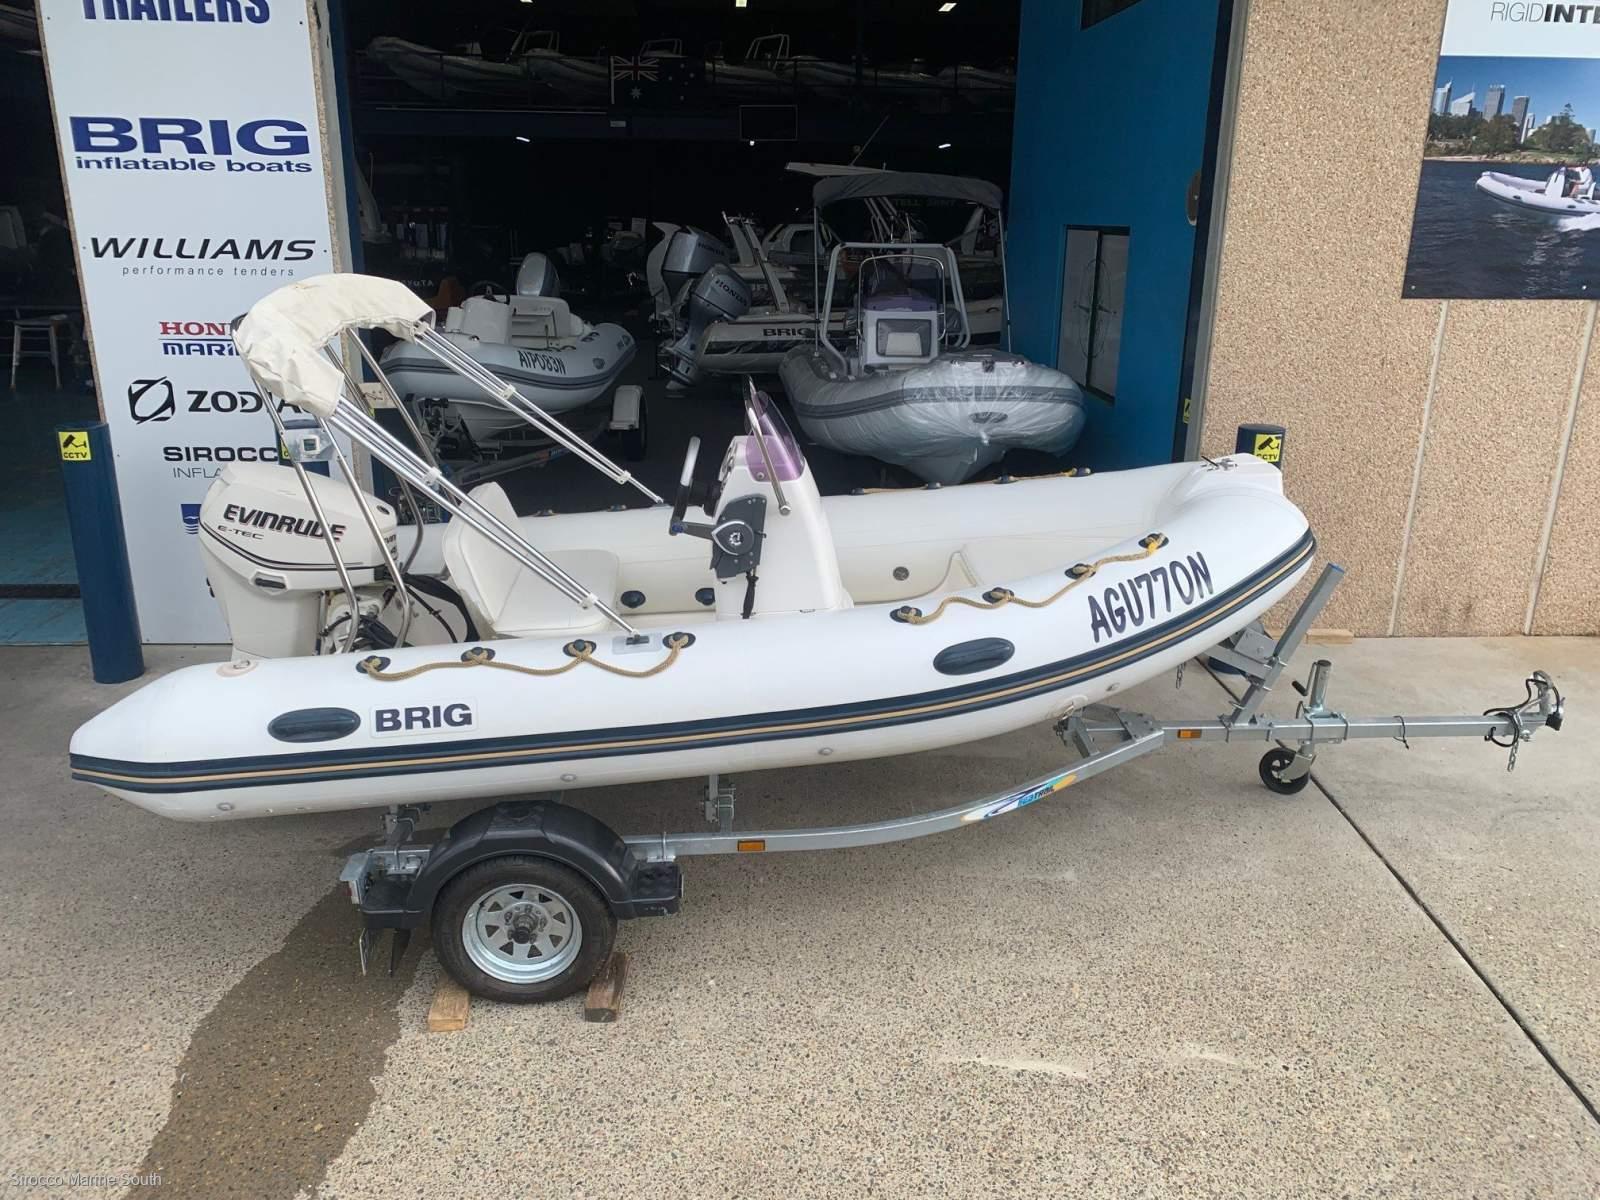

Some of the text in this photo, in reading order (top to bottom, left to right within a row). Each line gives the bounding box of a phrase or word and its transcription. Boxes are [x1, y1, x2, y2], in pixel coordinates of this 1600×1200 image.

[69, 116, 311, 156] BRIG
[76, 156, 313, 173] inflatable boats
[90, 237, 316, 261] WILLIAMS
[122, 265, 294, 277] performance tenders
[159, 321, 232, 336] HON
[162, 342, 241, 356] MARI
[187, 390, 312, 414] ZODA
[217, 525, 265, 540] E-TEC
[375, 703, 473, 733] BRIG
